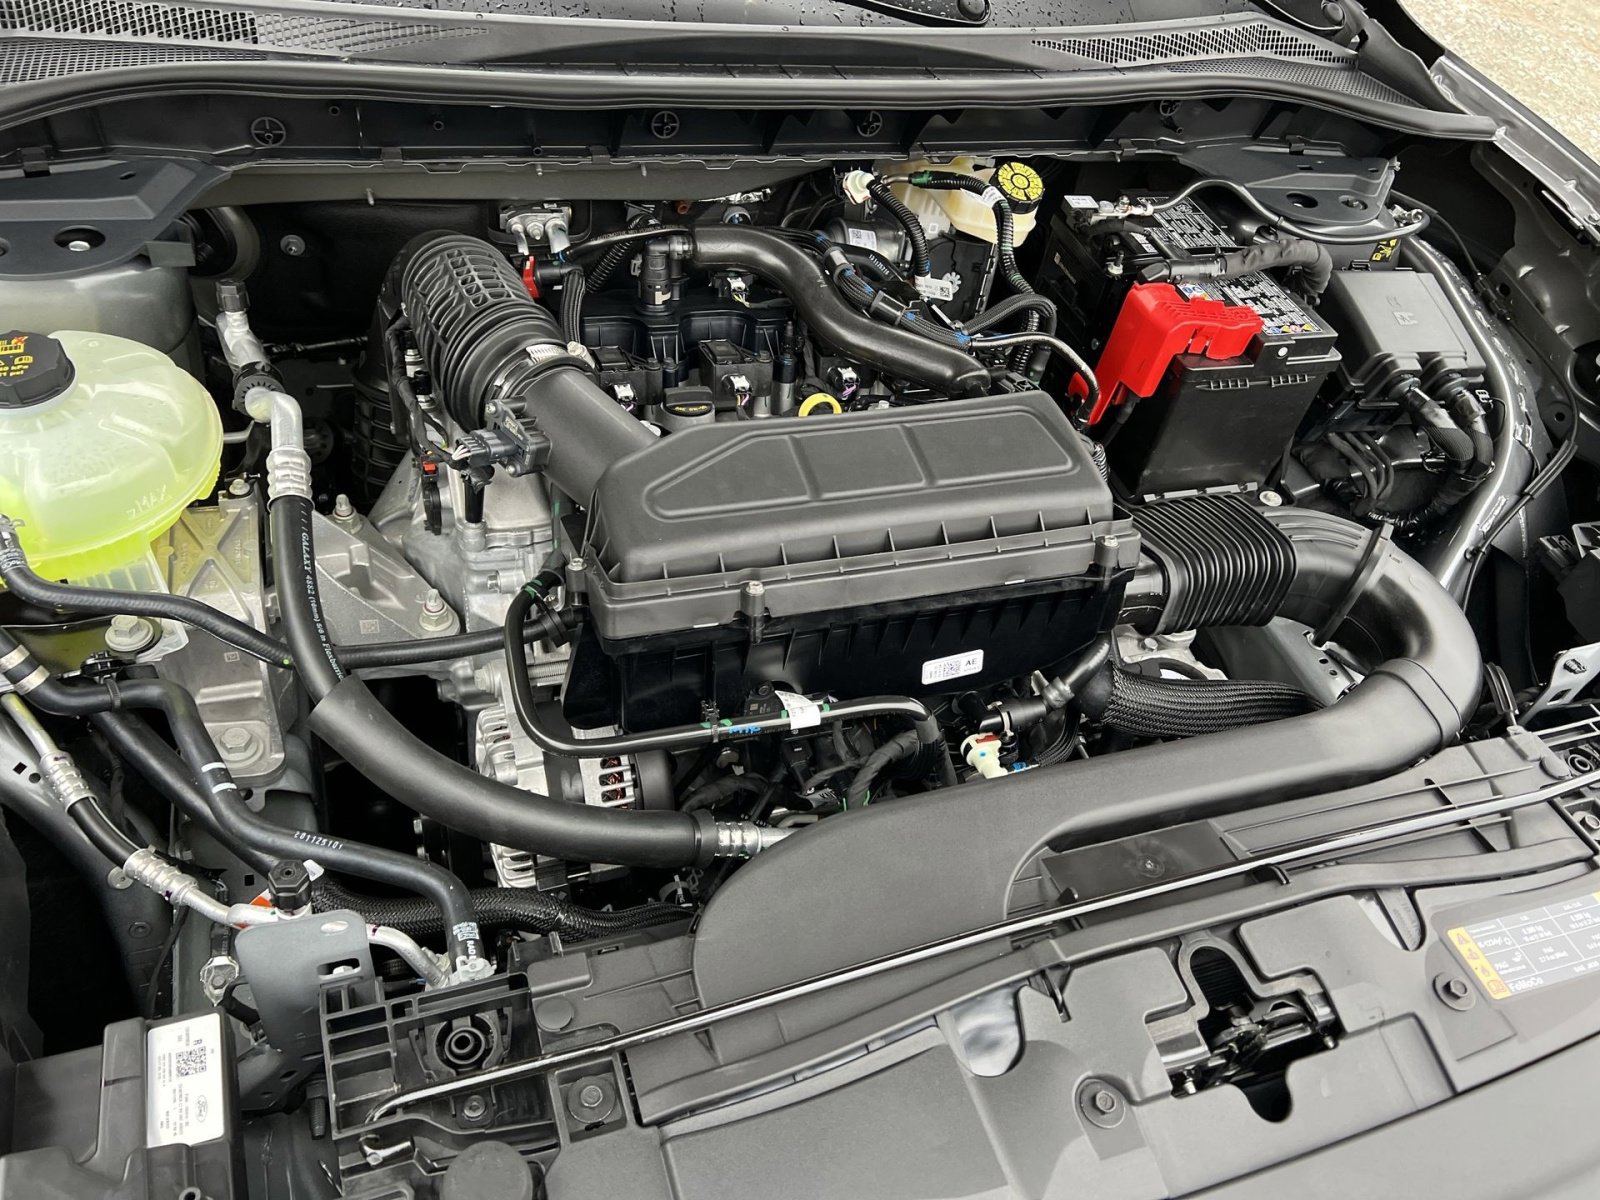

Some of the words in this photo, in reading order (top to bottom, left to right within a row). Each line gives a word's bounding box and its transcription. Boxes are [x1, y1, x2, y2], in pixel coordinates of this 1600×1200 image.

[301, 532, 312, 574] GALAXY
[965, 658, 978, 667] AE
[293, 830, 344, 850] 201125101
[466, 939, 477, 955] RAD
